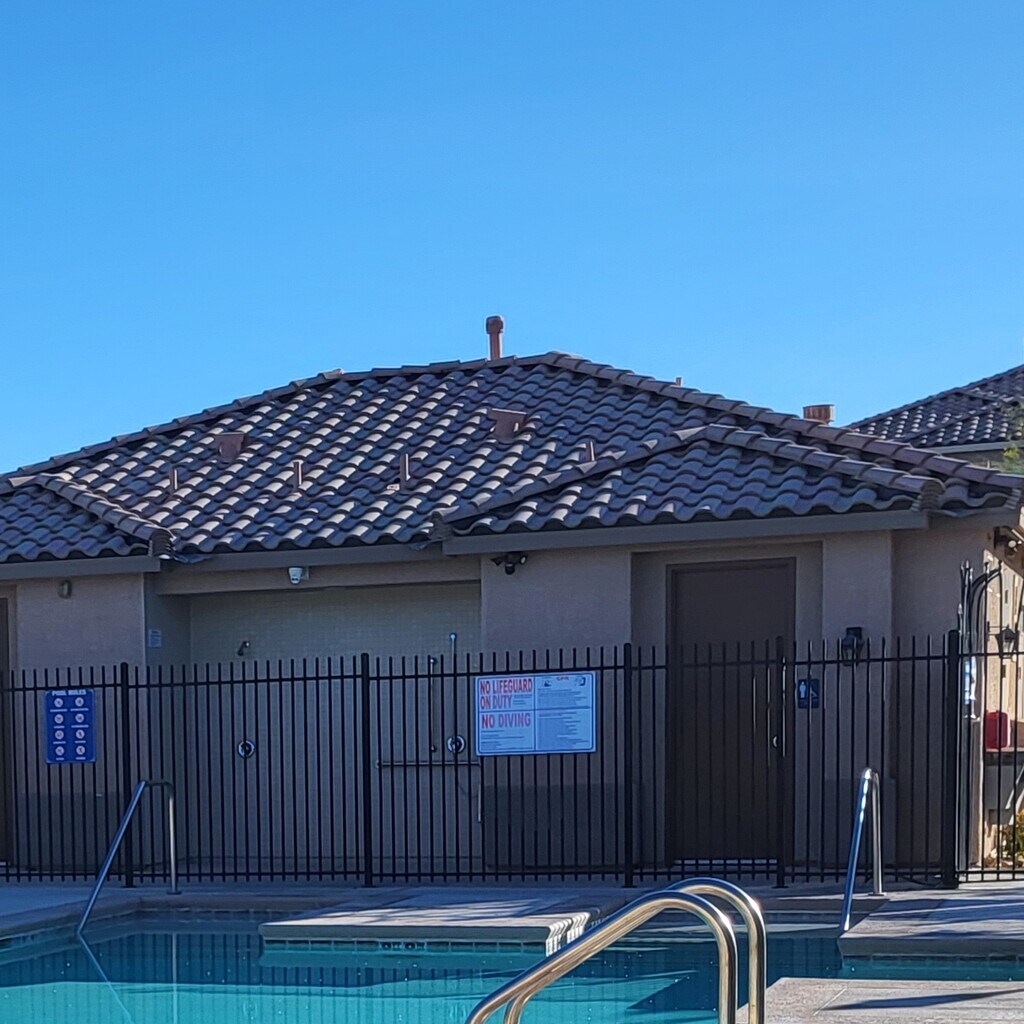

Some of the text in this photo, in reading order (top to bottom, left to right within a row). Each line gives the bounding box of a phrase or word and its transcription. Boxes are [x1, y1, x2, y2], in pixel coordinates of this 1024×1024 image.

[480, 678, 533, 694] NO LIFEGUARD
[480, 694, 511, 710] ON DUTY
[481, 713, 531, 728] NO DIVING
